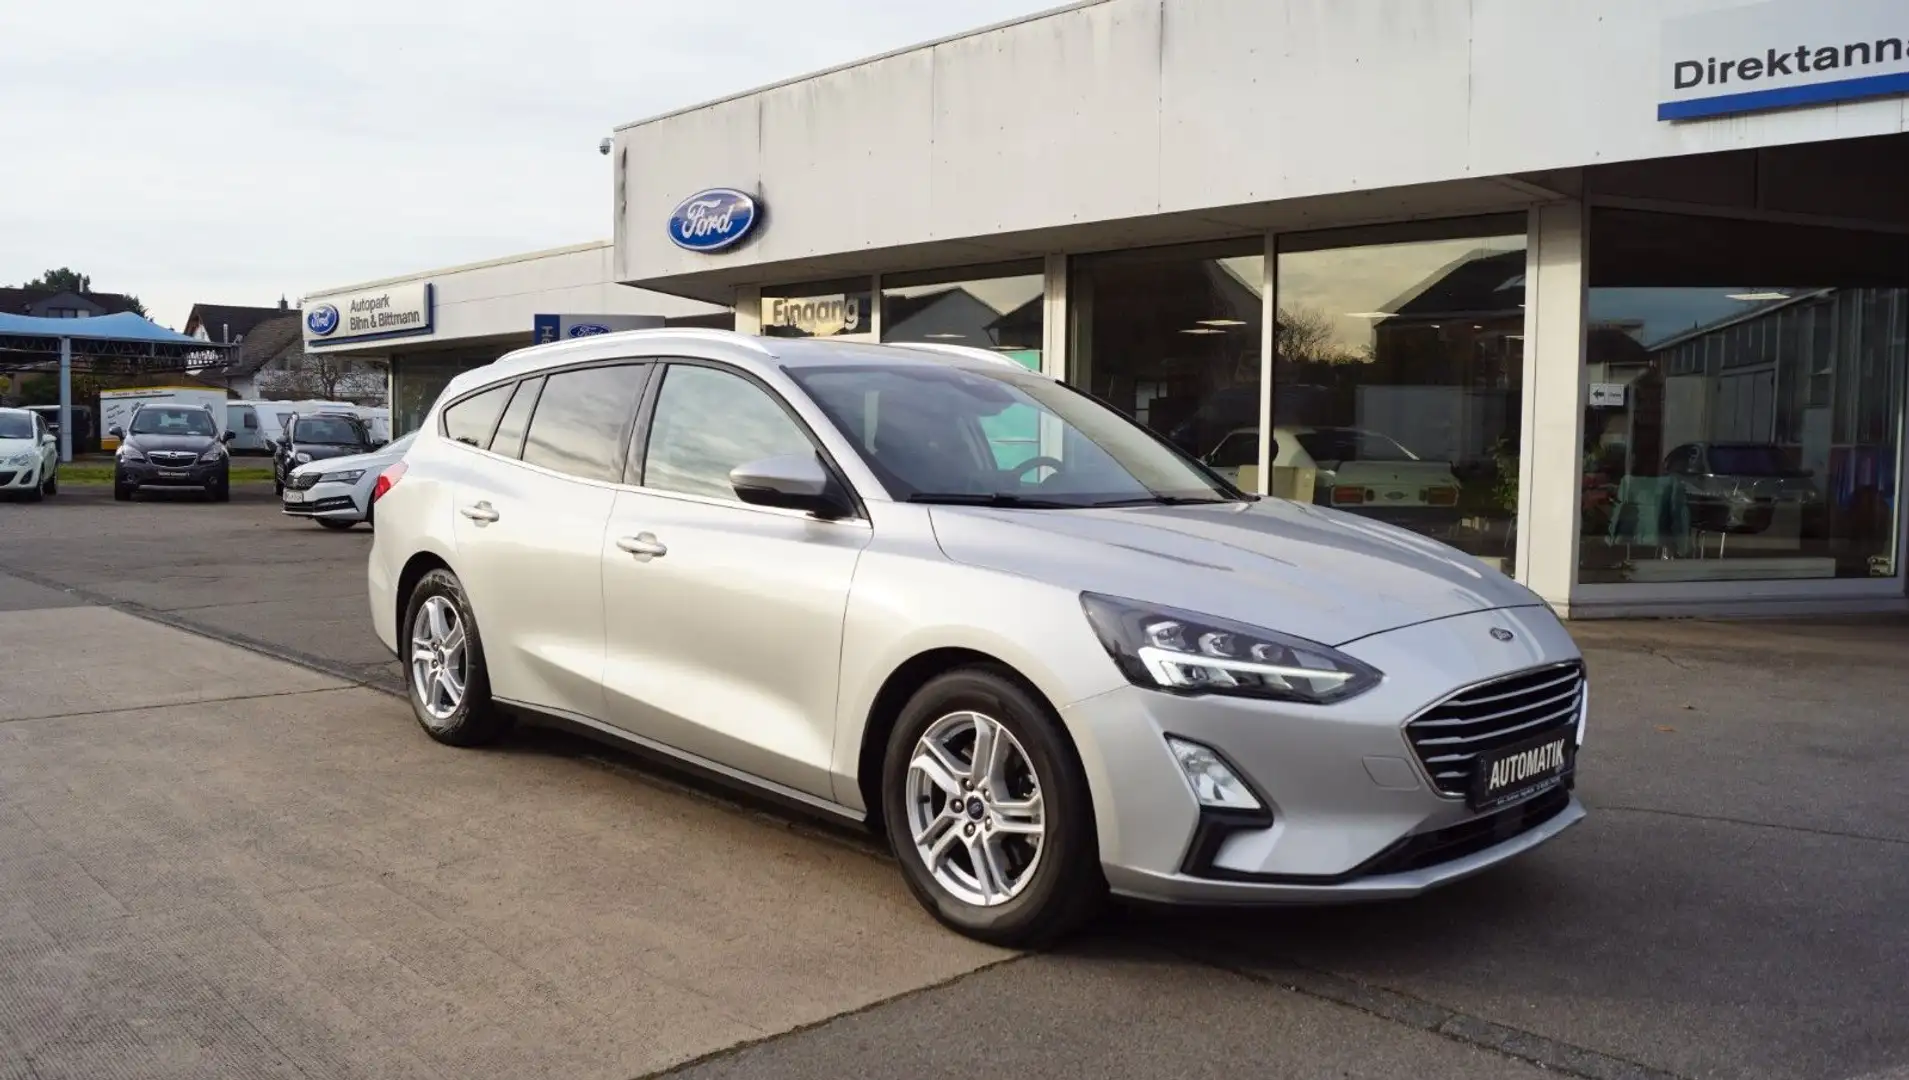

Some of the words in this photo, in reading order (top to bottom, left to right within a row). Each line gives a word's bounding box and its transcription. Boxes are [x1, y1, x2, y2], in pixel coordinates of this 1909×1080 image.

[1674, 37, 1909, 90] Direktann
[682, 200, 735, 238] Ford
[350, 294, 390, 313] Autopark
[371, 314, 377, 327] &
[379, 310, 420, 327] Bittmann
[773, 296, 859, 332] Eingang
[1489, 739, 1565, 790] AUTOMATIK
